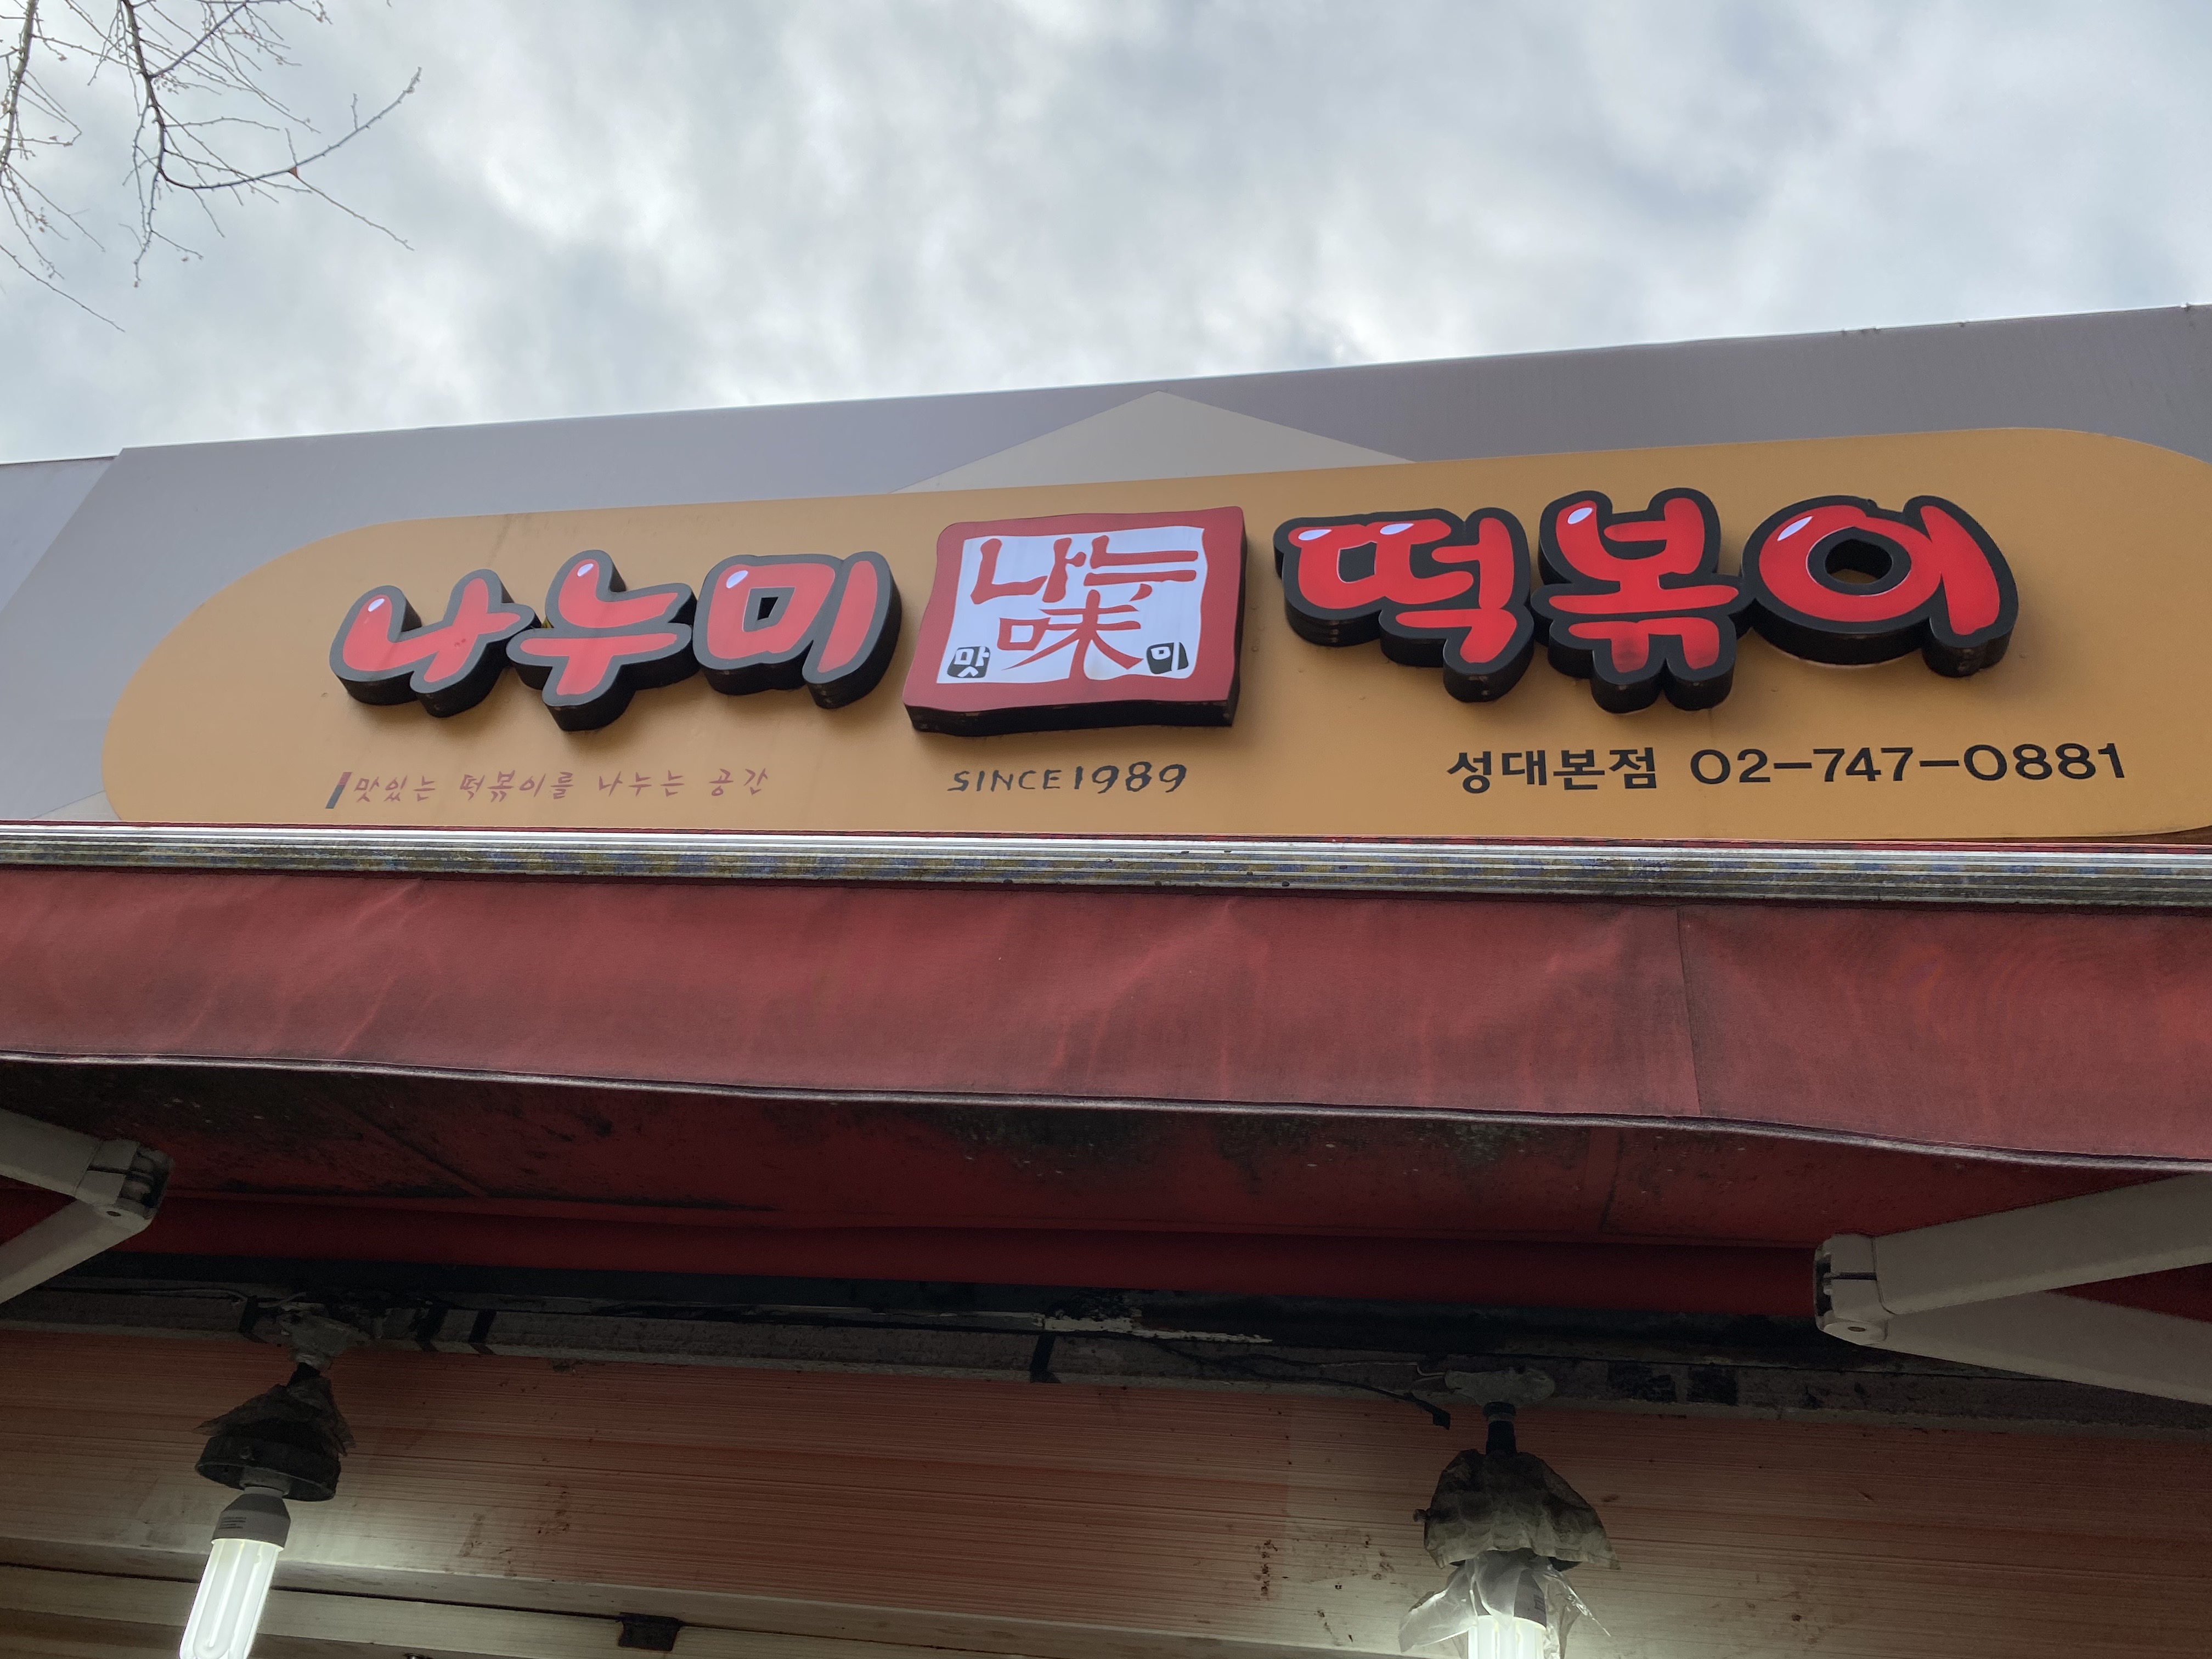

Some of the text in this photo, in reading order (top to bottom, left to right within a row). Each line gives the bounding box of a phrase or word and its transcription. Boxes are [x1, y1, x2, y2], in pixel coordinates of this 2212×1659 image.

[330, 488, 2019, 721] 나누미 떡볶이
[354, 768, 769, 803] 맛있는 떡볶이를 나누는 공간
[1447, 742, 2125, 794] 성대본점 02-747-0881
